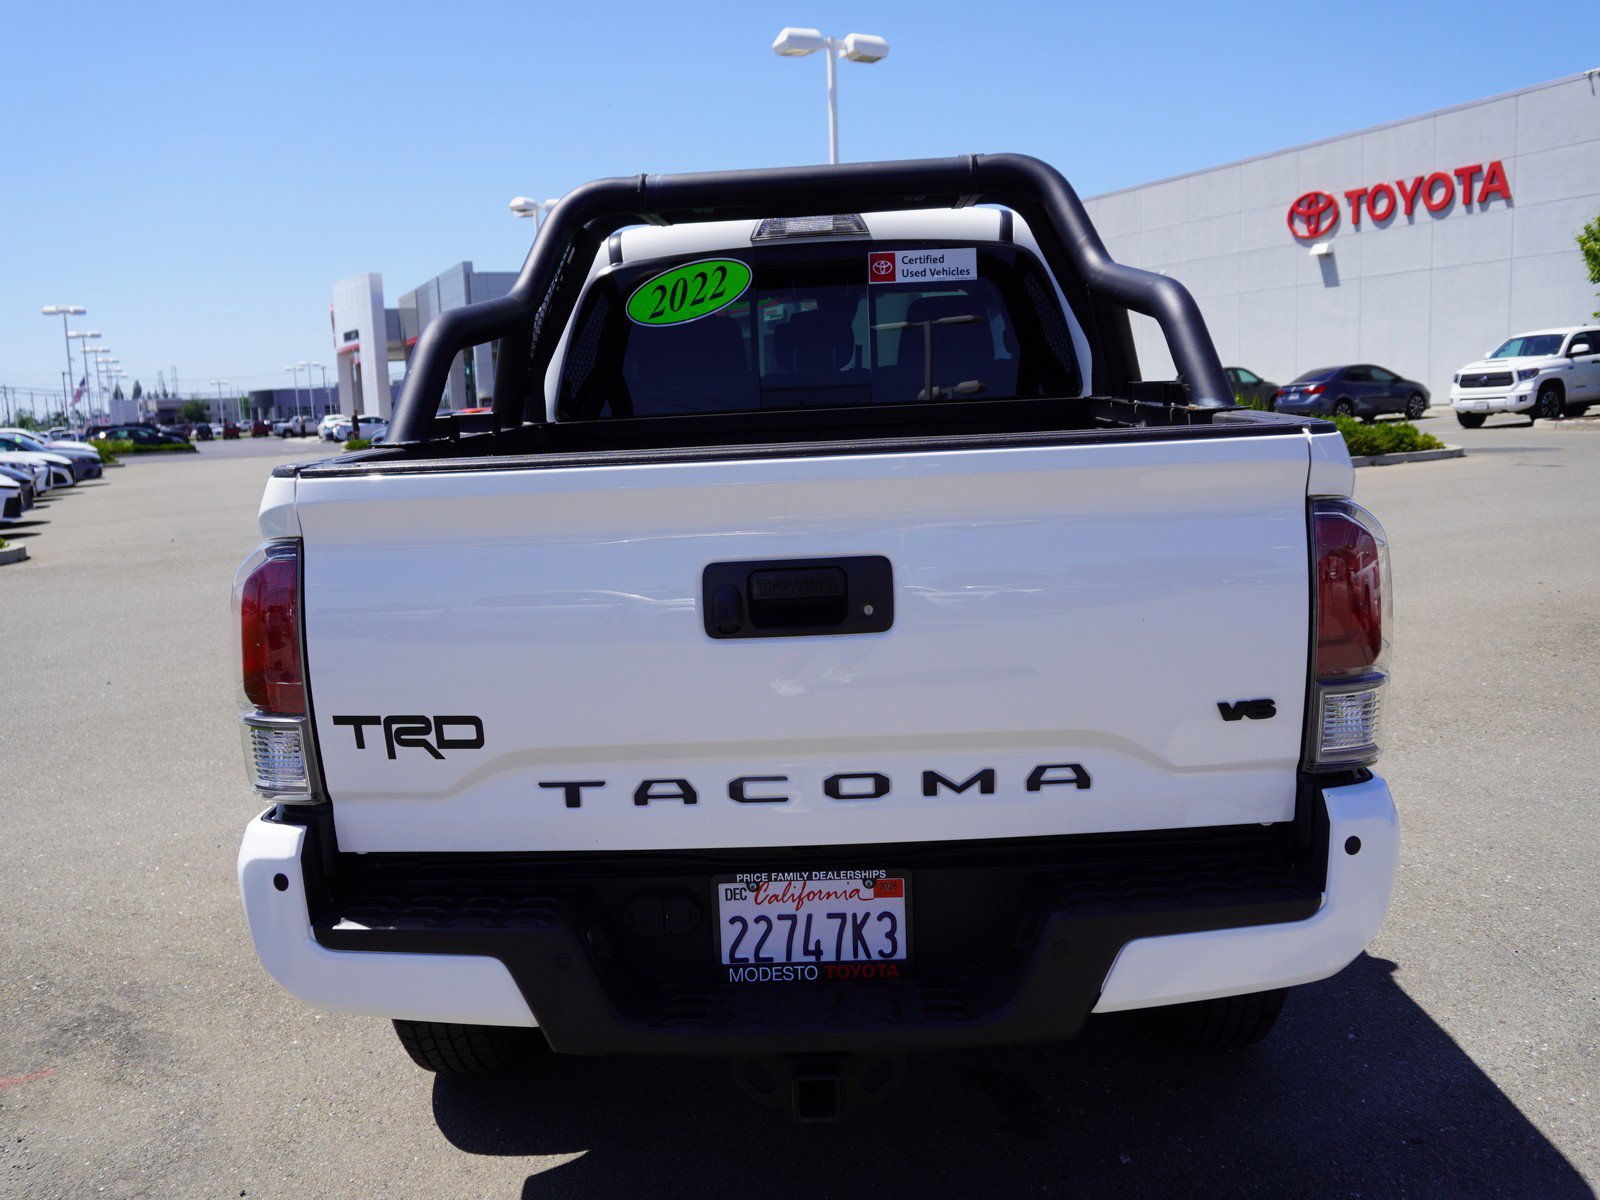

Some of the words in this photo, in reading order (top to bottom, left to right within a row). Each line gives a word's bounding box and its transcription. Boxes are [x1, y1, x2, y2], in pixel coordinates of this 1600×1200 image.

[1344, 160, 1511, 225] TOYOTA
[901, 254, 945, 266] Certified
[901, 266, 927, 278] Used
[929, 266, 970, 277] Vehicles
[648, 265, 728, 320] 2022
[757, 576, 839, 597] TOYOTA
[1216, 699, 1277, 721] V6
[332, 715, 485, 760] TRD
[538, 763, 1091, 808] TACOMA
[736, 873, 768, 883] PRICE
[771, 871, 809, 881] FAMILY
[812, 870, 887, 881] DEALERSHIPS
[725, 887, 747, 901] DEC
[754, 881, 874, 912] California
[728, 911, 898, 964] 22747K3
[729, 965, 819, 983] MODESTO
[826, 964, 900, 980] TOYOTA
